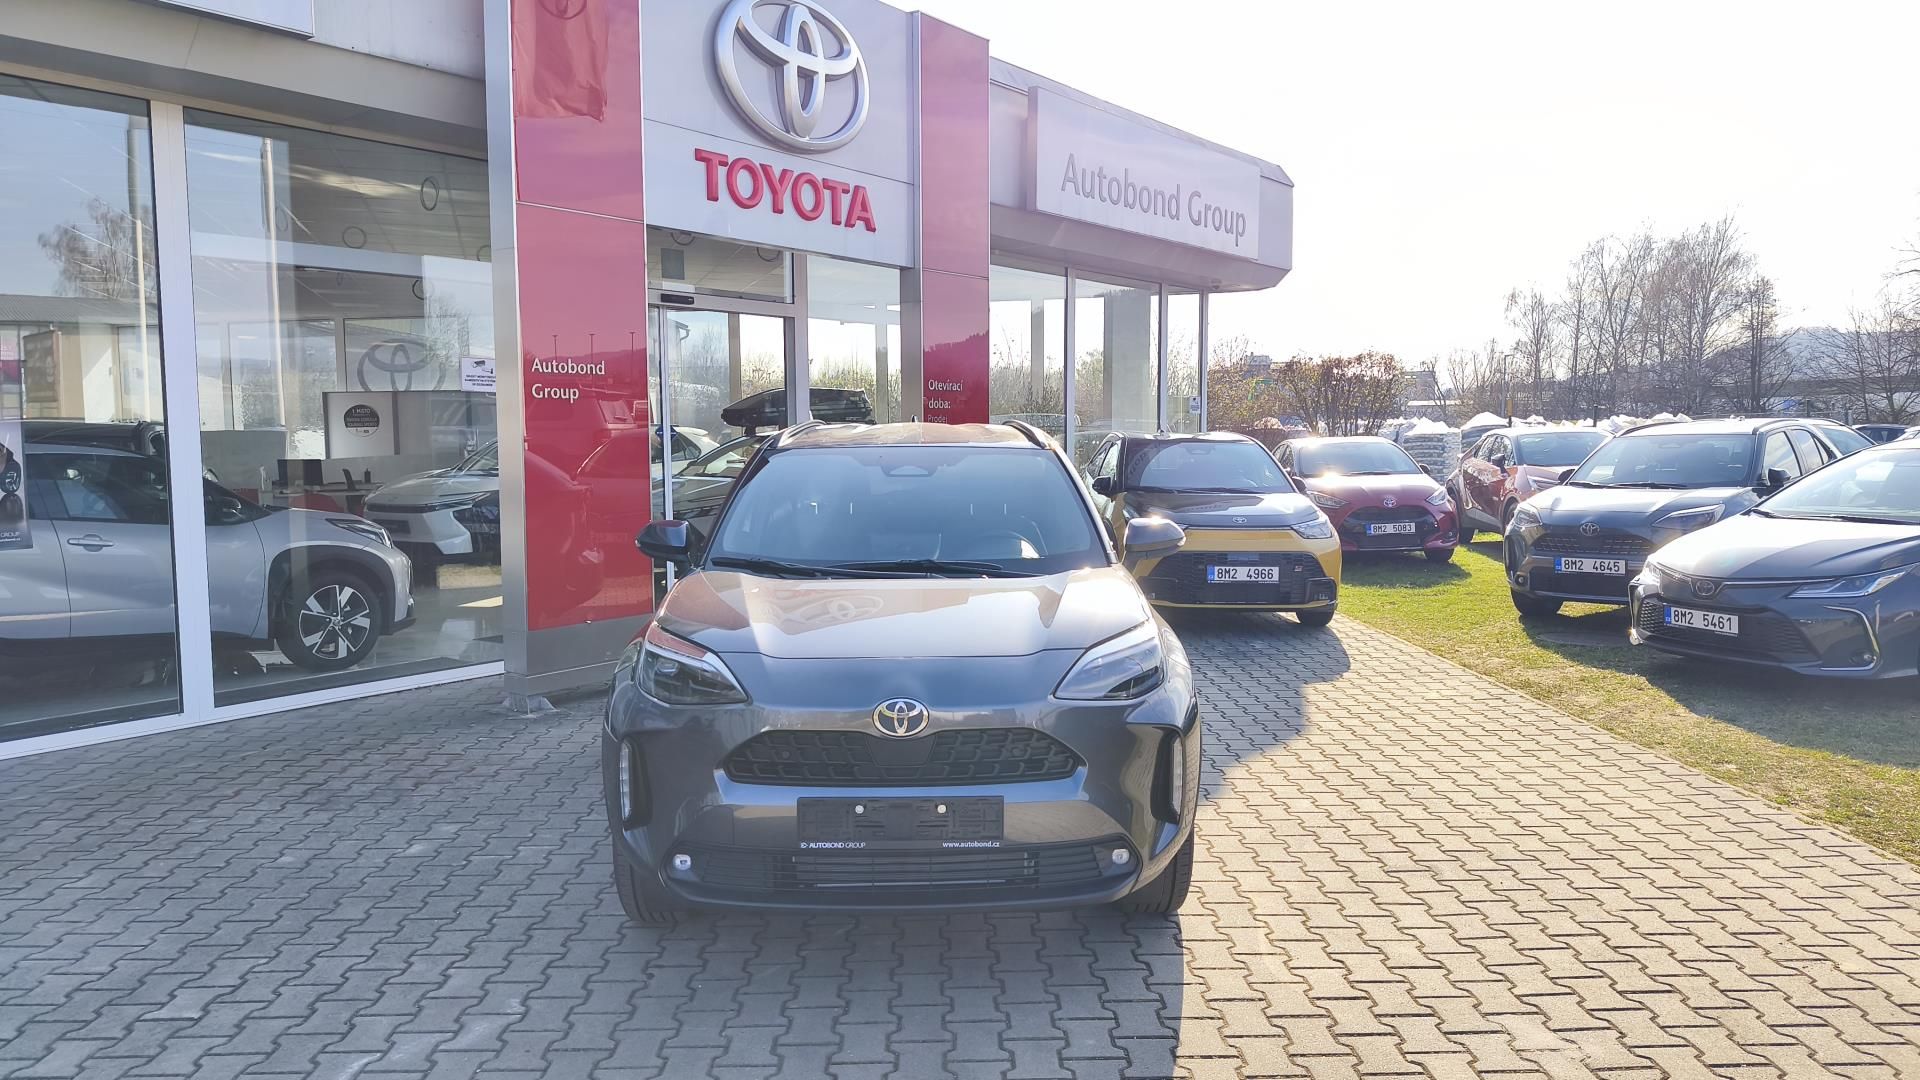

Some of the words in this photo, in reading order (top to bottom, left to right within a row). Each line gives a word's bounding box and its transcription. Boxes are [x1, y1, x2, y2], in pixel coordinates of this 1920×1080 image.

[694, 147, 877, 233] TOYOTA
[1061, 152, 1181, 221] Autobond
[1187, 190, 1247, 247] Group
[531, 357, 606, 375] Autobond
[531, 383, 579, 404] Group
[928, 379, 964, 392] Otevírací
[928, 397, 951, 409] doba:
[1216, 567, 1238, 580] 8M2
[1246, 567, 1274, 580] 4966
[1563, 559, 1584, 571] 8M2
[1592, 560, 1620, 573] 4645
[1673, 609, 1694, 625] 8M2
[1702, 613, 1732, 631] 5461
[942, 840, 1000, 848] www.autobond.cz
